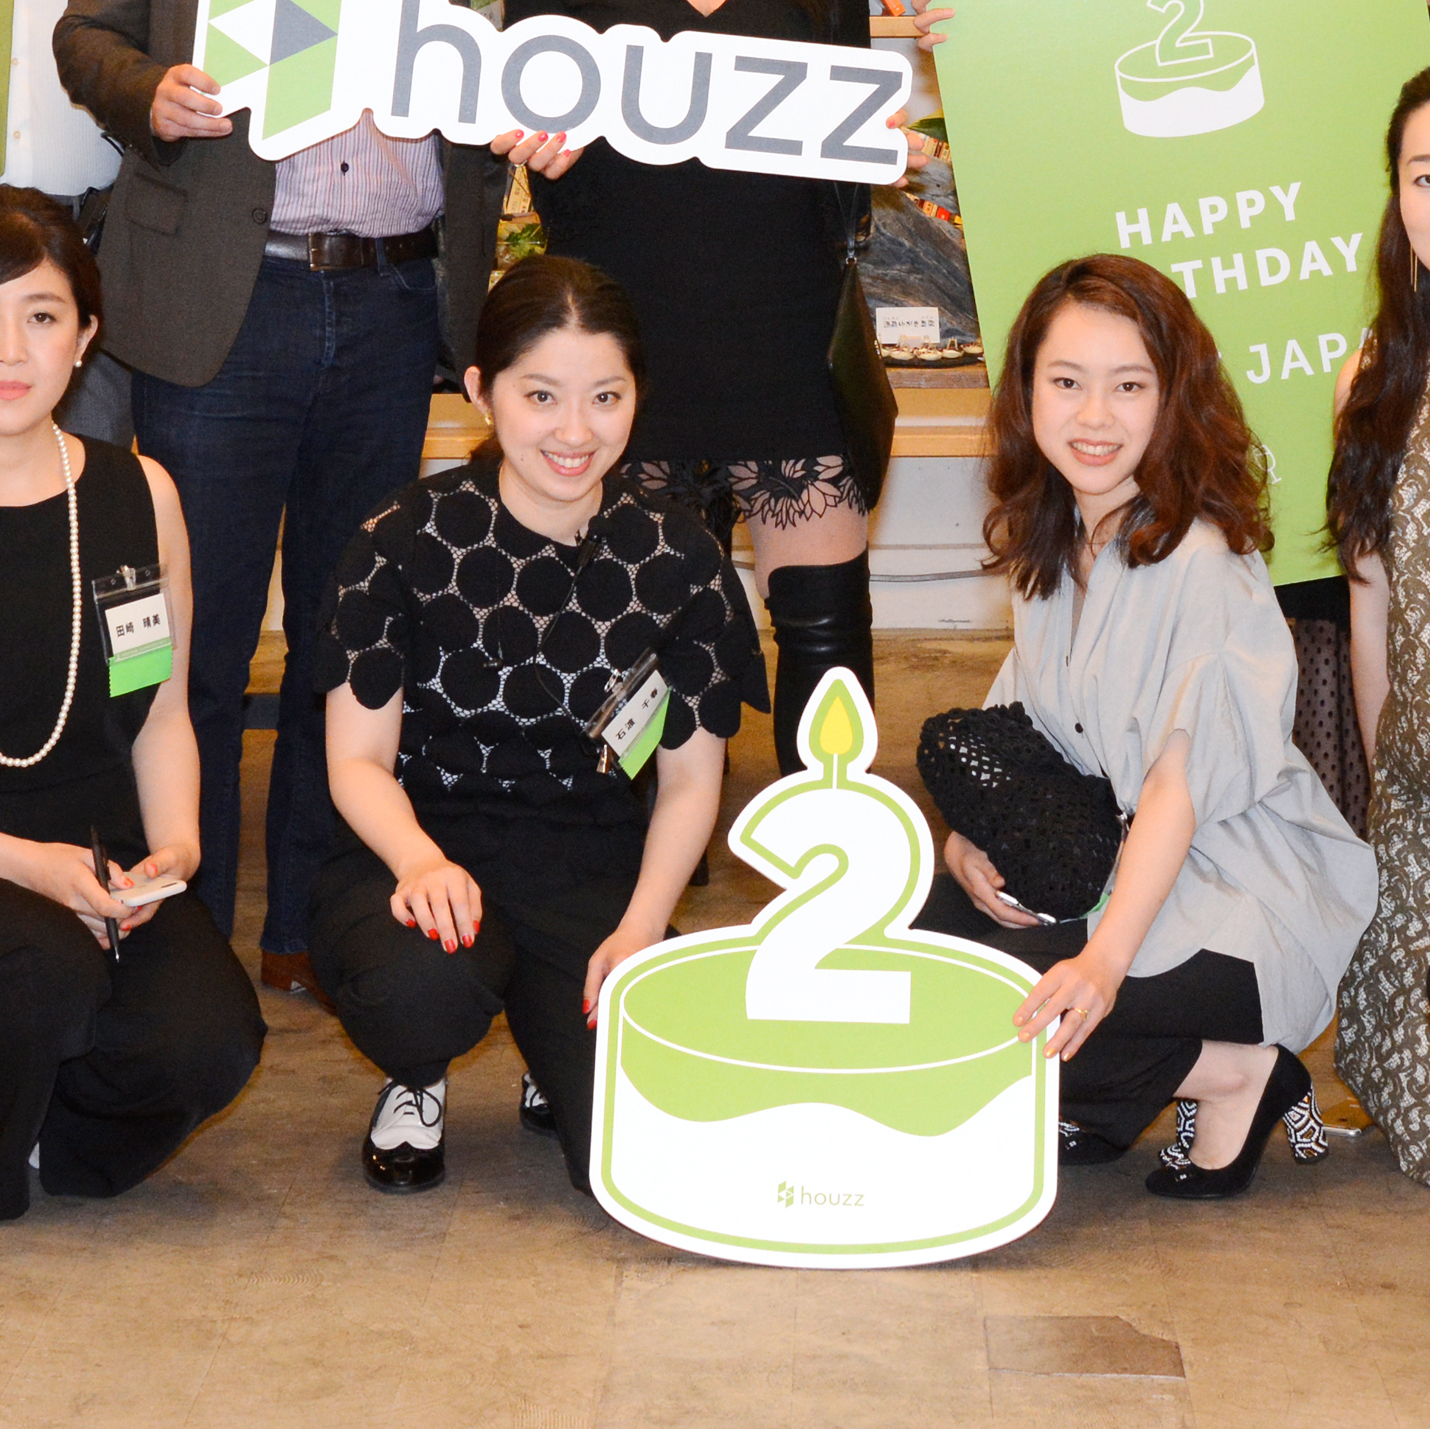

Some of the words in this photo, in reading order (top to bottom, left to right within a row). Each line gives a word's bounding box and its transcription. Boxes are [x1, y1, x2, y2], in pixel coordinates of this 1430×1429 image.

[1115, 180, 1304, 250] HAPPY
[1170, 232, 1365, 301] THDAY
[1245, 326, 1373, 385] JAP
[745, 787, 912, 1025] 2
[800, 1185, 865, 1208] houzz
